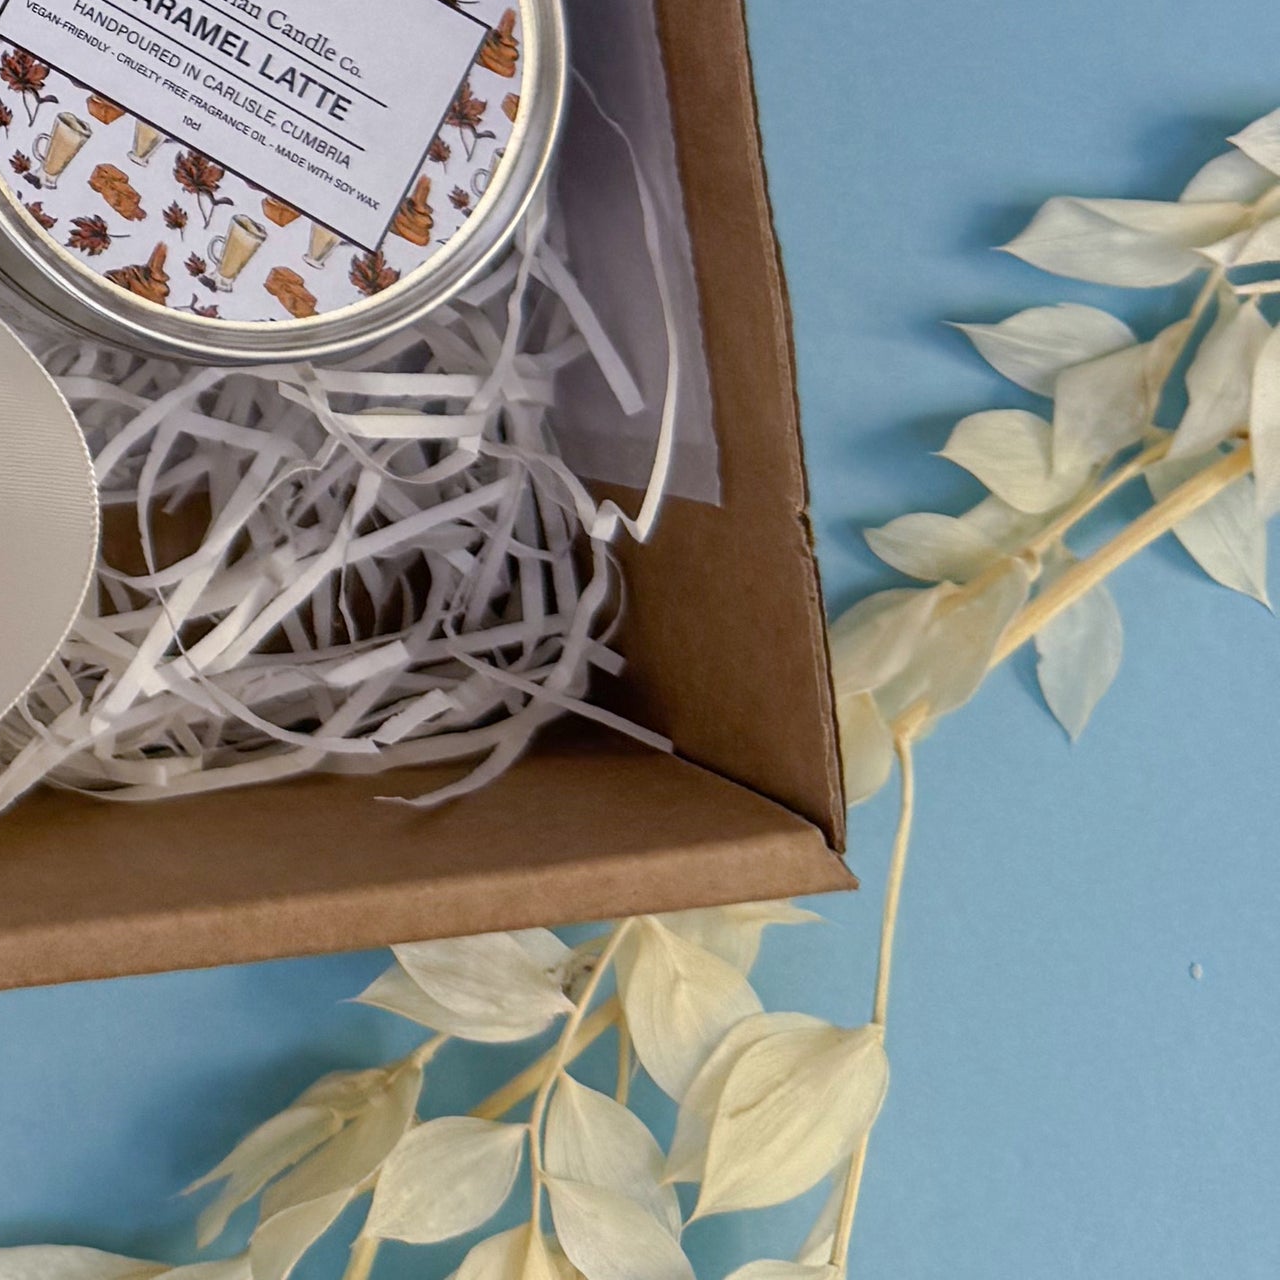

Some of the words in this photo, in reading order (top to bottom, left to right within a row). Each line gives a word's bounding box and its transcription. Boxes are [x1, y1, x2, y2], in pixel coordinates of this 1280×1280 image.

[73, 0, 181, 69] HANDPOURED
[182, 62, 202, 81] IN
[202, 74, 277, 127] CARLISLE,
[281, 120, 351, 169] CUMBRIA
[258, 54, 352, 122] LATTE
[267, 9, 337, 62] Candle
[339, 56, 363, 78] Co.
[26, 0, 111, 53] VEGAN-FRIENDLY
[116, 52, 162, 83] CRUELTY
[162, 78, 188, 100] FREE
[188, 94, 250, 135] FRAGRANCE
[250, 130, 268, 147] OIL
[275, 144, 307, 168] MADE
[307, 162, 334, 184] WITH
[333, 178, 356, 196] SOY
[356, 191, 381, 211] WAX
